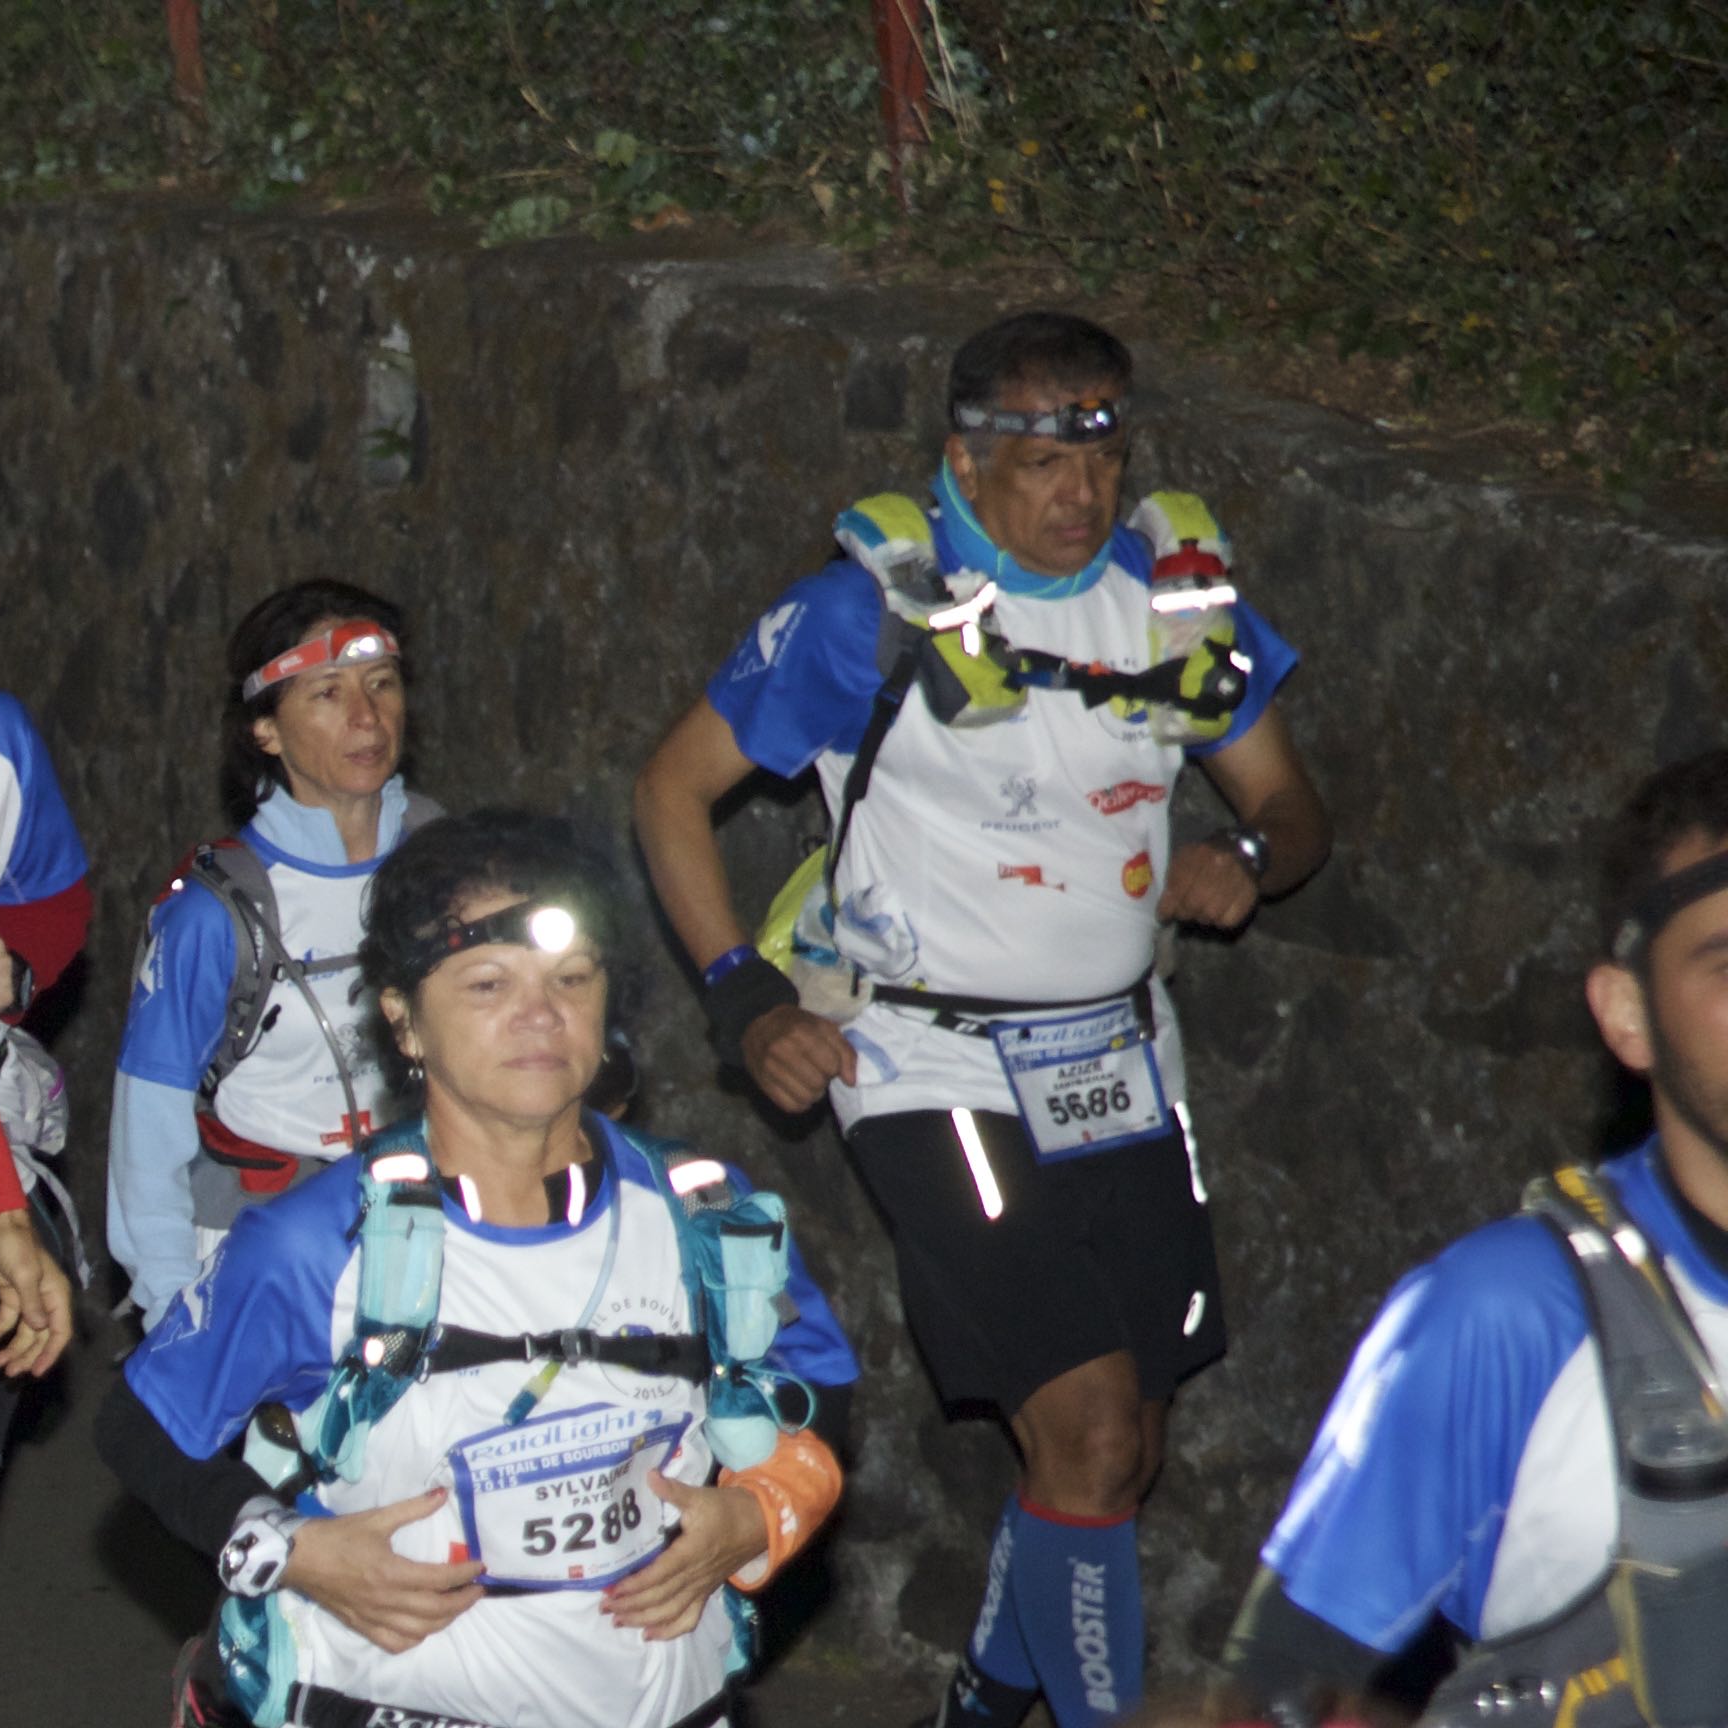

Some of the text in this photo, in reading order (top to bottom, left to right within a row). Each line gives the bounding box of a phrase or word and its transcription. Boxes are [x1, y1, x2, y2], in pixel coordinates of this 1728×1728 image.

[1045, 1079, 1132, 1126] 5686
[496, 1461, 538, 1480] TRAIL
[540, 1455, 560, 1469] DE
[562, 1439, 631, 1466] BOURBON
[534, 1459, 634, 1502] SYLVAINE
[571, 1486, 616, 1509] PAYET
[521, 1487, 642, 1558] 5288
[1070, 1562, 1118, 1714] BOOSTER
